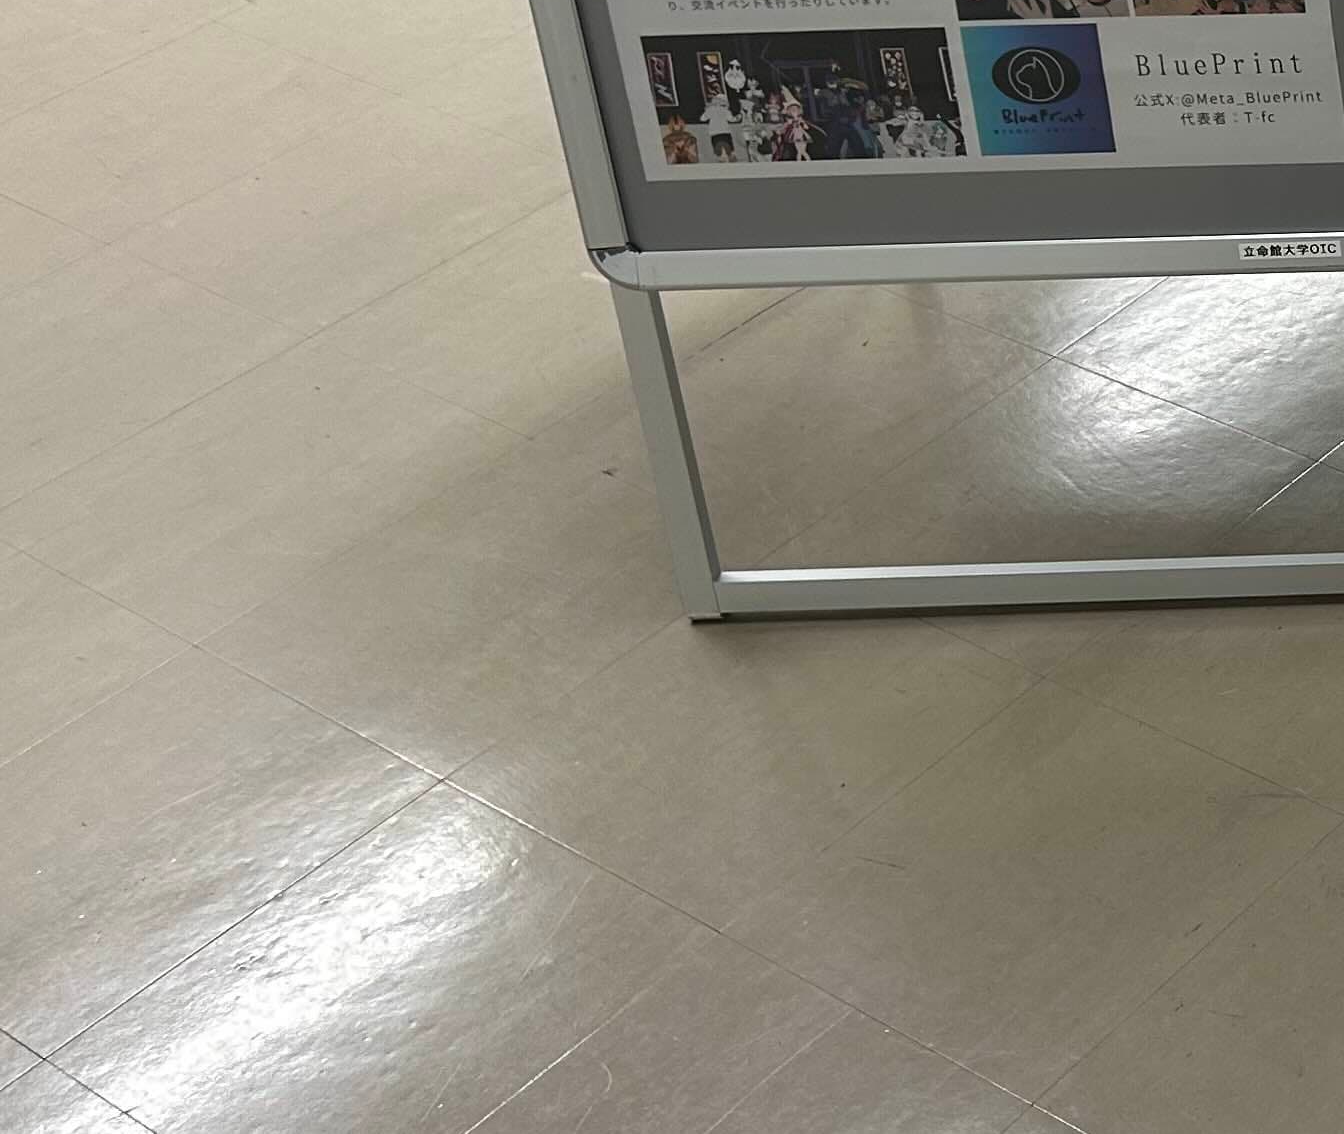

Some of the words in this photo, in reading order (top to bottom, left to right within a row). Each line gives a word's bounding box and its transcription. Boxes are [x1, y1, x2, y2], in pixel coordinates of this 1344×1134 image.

[1135, 52, 1303, 77] BluePrint
[1001, 108, 1085, 124] BluePrint
[1243, 242, 1337, 258] 立命館大学OIC
